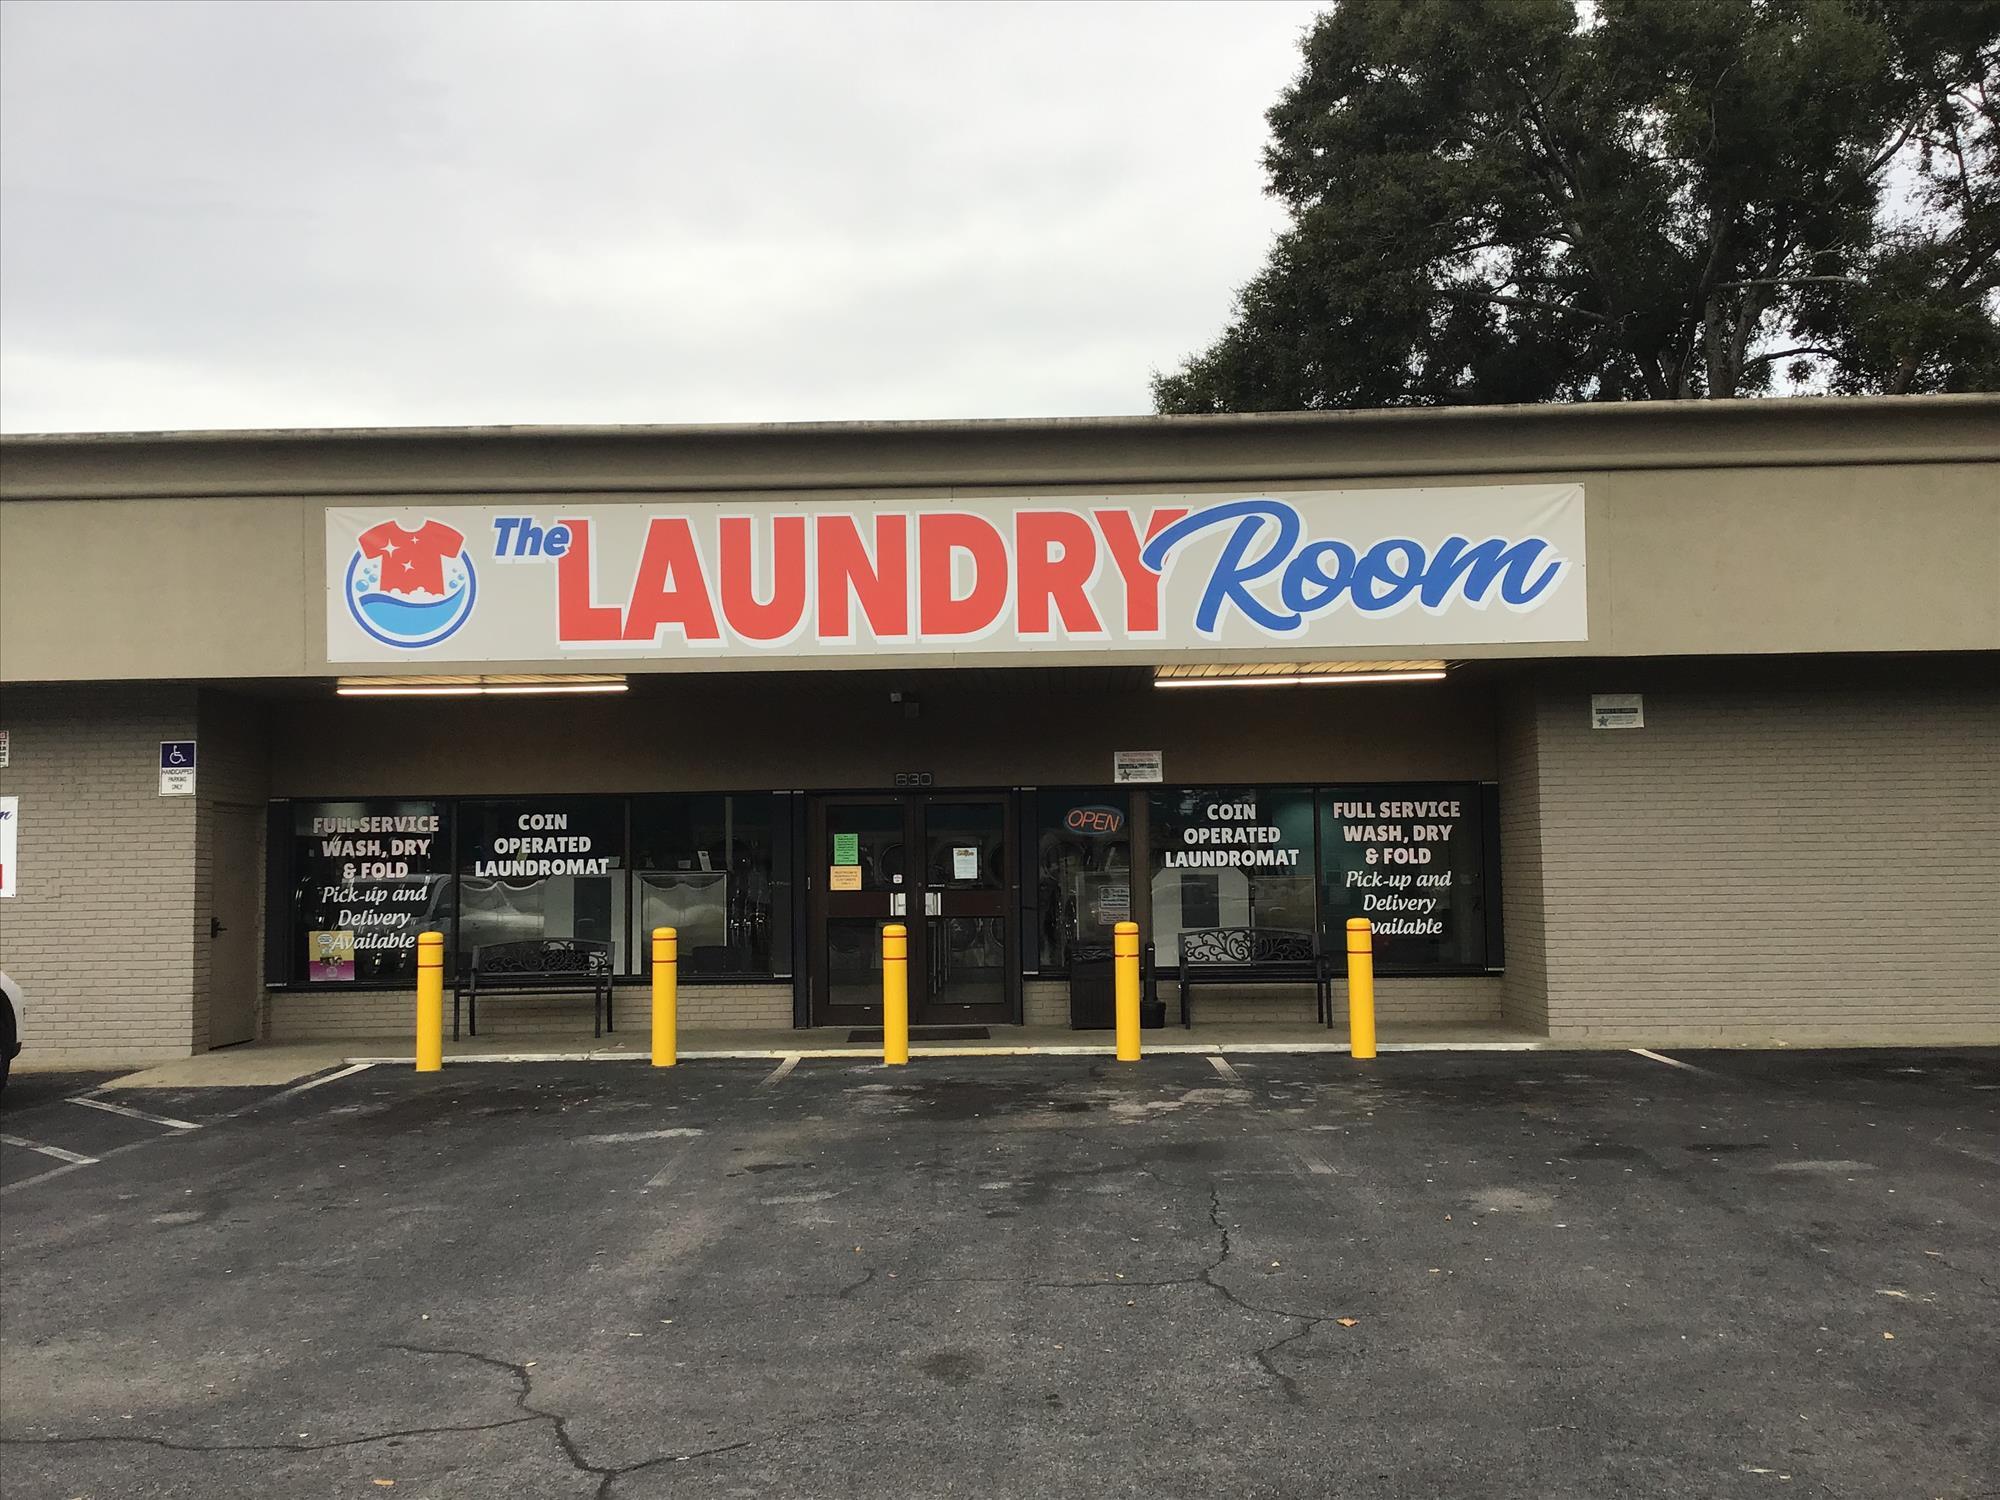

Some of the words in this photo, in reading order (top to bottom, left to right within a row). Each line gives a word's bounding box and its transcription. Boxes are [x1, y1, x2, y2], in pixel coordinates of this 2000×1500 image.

[493, 517, 570, 556] The
[558, 508, 1189, 641] LAUNDRY
[1142, 500, 1562, 633] Room
[1207, 803, 1257, 820] COIN
[1333, 802, 1376, 818] FULL
[1380, 801, 1460, 818] SERVICE
[313, 817, 355, 834] FULL
[359, 815, 440, 833] SERVICE
[518, 813, 567, 830] COIN
[1067, 809, 1121, 833] OPEN
[1183, 826, 1281, 845] OPERATED
[1343, 825, 1409, 844] WASH,
[1413, 824, 1453, 841] DRY
[322, 839, 387, 858] WASH,
[391, 838, 431, 857] DRY
[493, 836, 592, 854] OPERATED
[1165, 849, 1299, 868] LAUNDROMAT
[1365, 848, 1379, 865] &
[1383, 847, 1432, 864] FOLD
[343, 863, 357, 879] &
[361, 862, 409, 879] FOLD
[475, 858, 609, 877] LAUNDROMAT
[1346, 871, 1412, 890] Pick-up
[1416, 870, 1453, 887] and
[322, 886, 387, 905] Pick-up
[392, 885, 428, 901] and
[1363, 894, 1437, 914] Delivery
[338, 909, 411, 928] Delivery
[1371, 918, 1443, 935] vailable
[331, 932, 415, 949] Available
